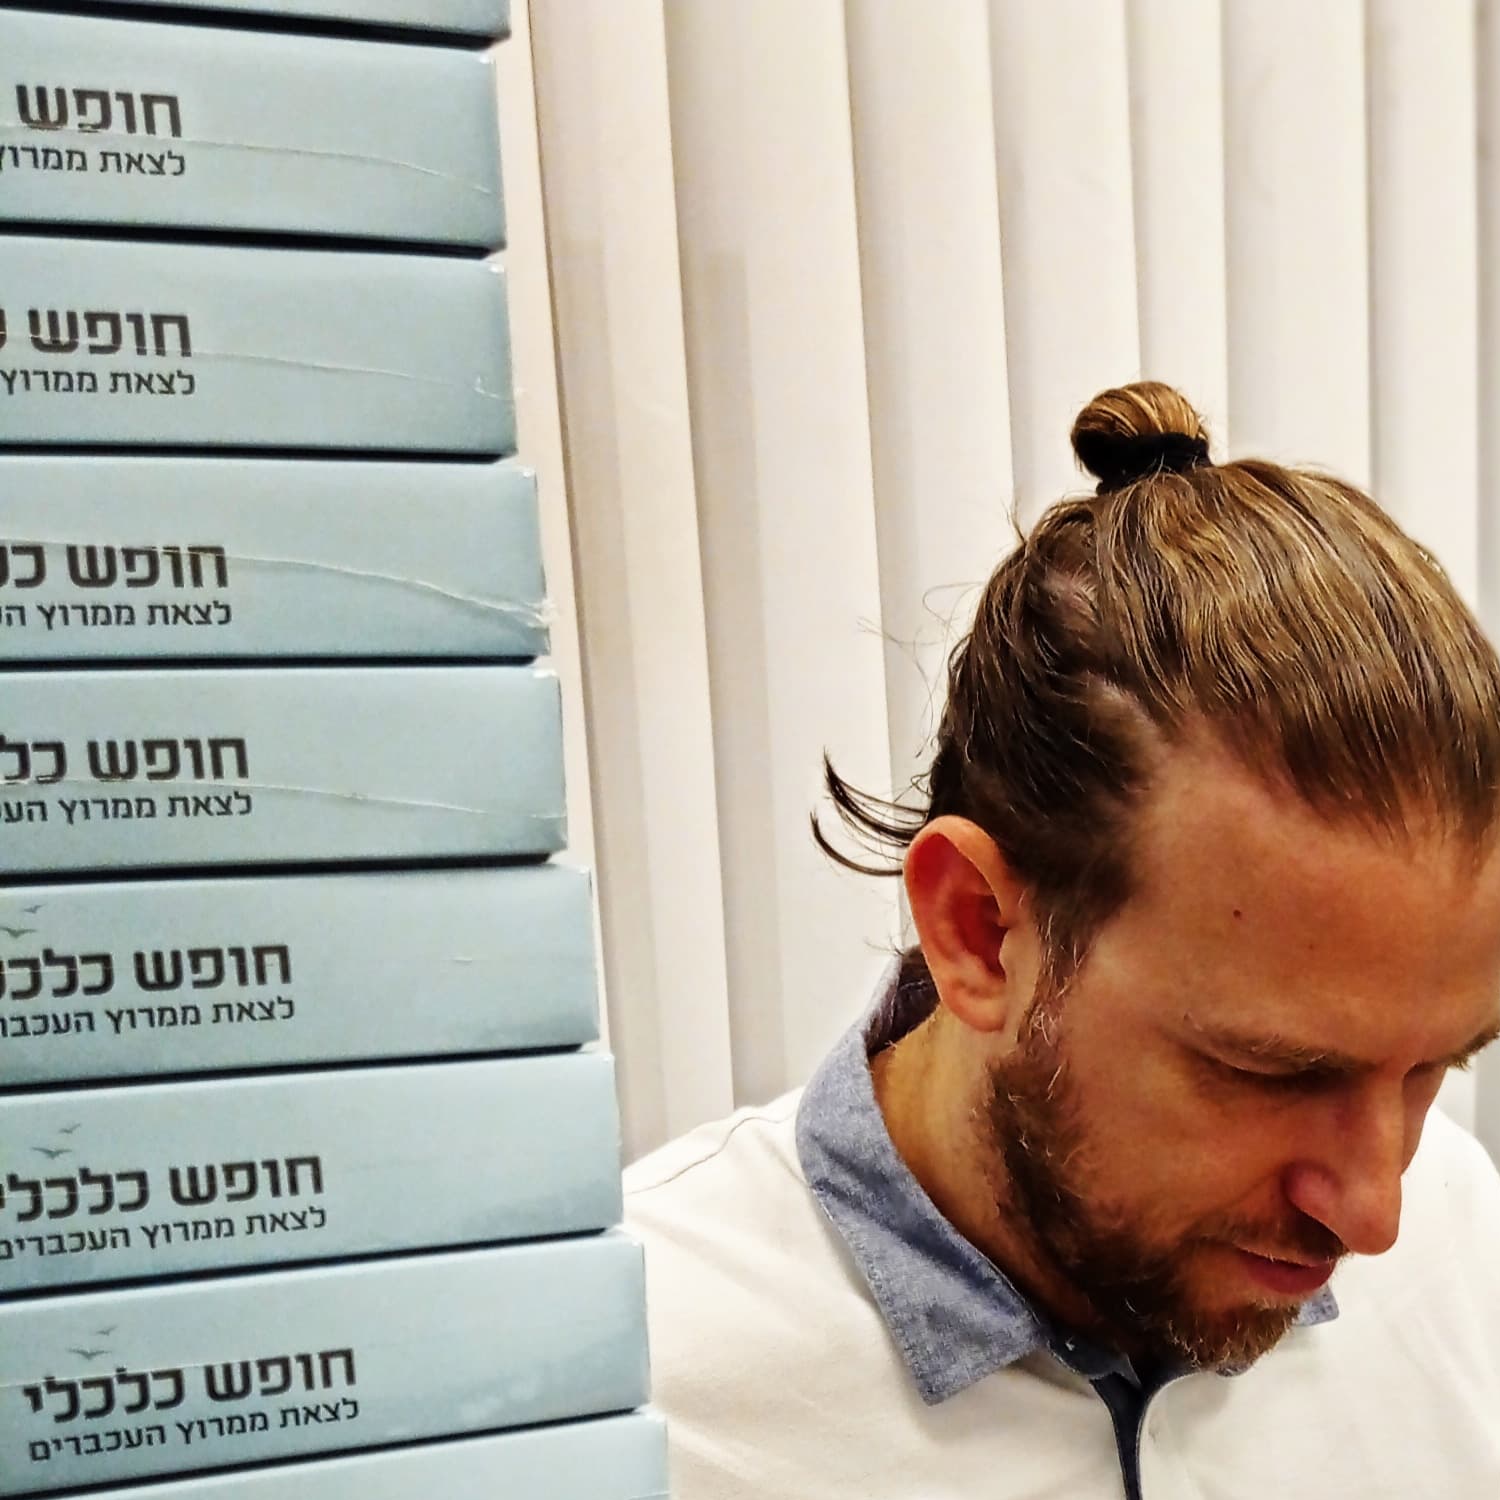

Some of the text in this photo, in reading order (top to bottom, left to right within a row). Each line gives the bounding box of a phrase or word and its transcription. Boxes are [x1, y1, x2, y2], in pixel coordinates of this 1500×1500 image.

[16, 85, 181, 137] חופש
[100, 150, 185, 176] לצאת
[28, 309, 191, 357] חופש
[0, 370, 194, 395] לצאת ממרוץ
[66, 545, 227, 587] חופש
[37, 604, 135, 630] ממרוץ
[148, 600, 231, 626] לצאת
[87, 738, 248, 782] חופש
[58, 797, 156, 825] ממרוץ
[168, 791, 251, 817] לצאת
[0, 945, 290, 1000] חופש כלכ
[0, 995, 294, 1038] לצאת ממרוץ העכב
[170, 1156, 322, 1206] חופש
[141, 1218, 234, 1249] ממרוץ
[246, 1206, 325, 1235] לצאת
[24, 1348, 355, 1423] חופש כלכלי
[29, 1397, 358, 1461] לצאת ממרוץ העכברים
